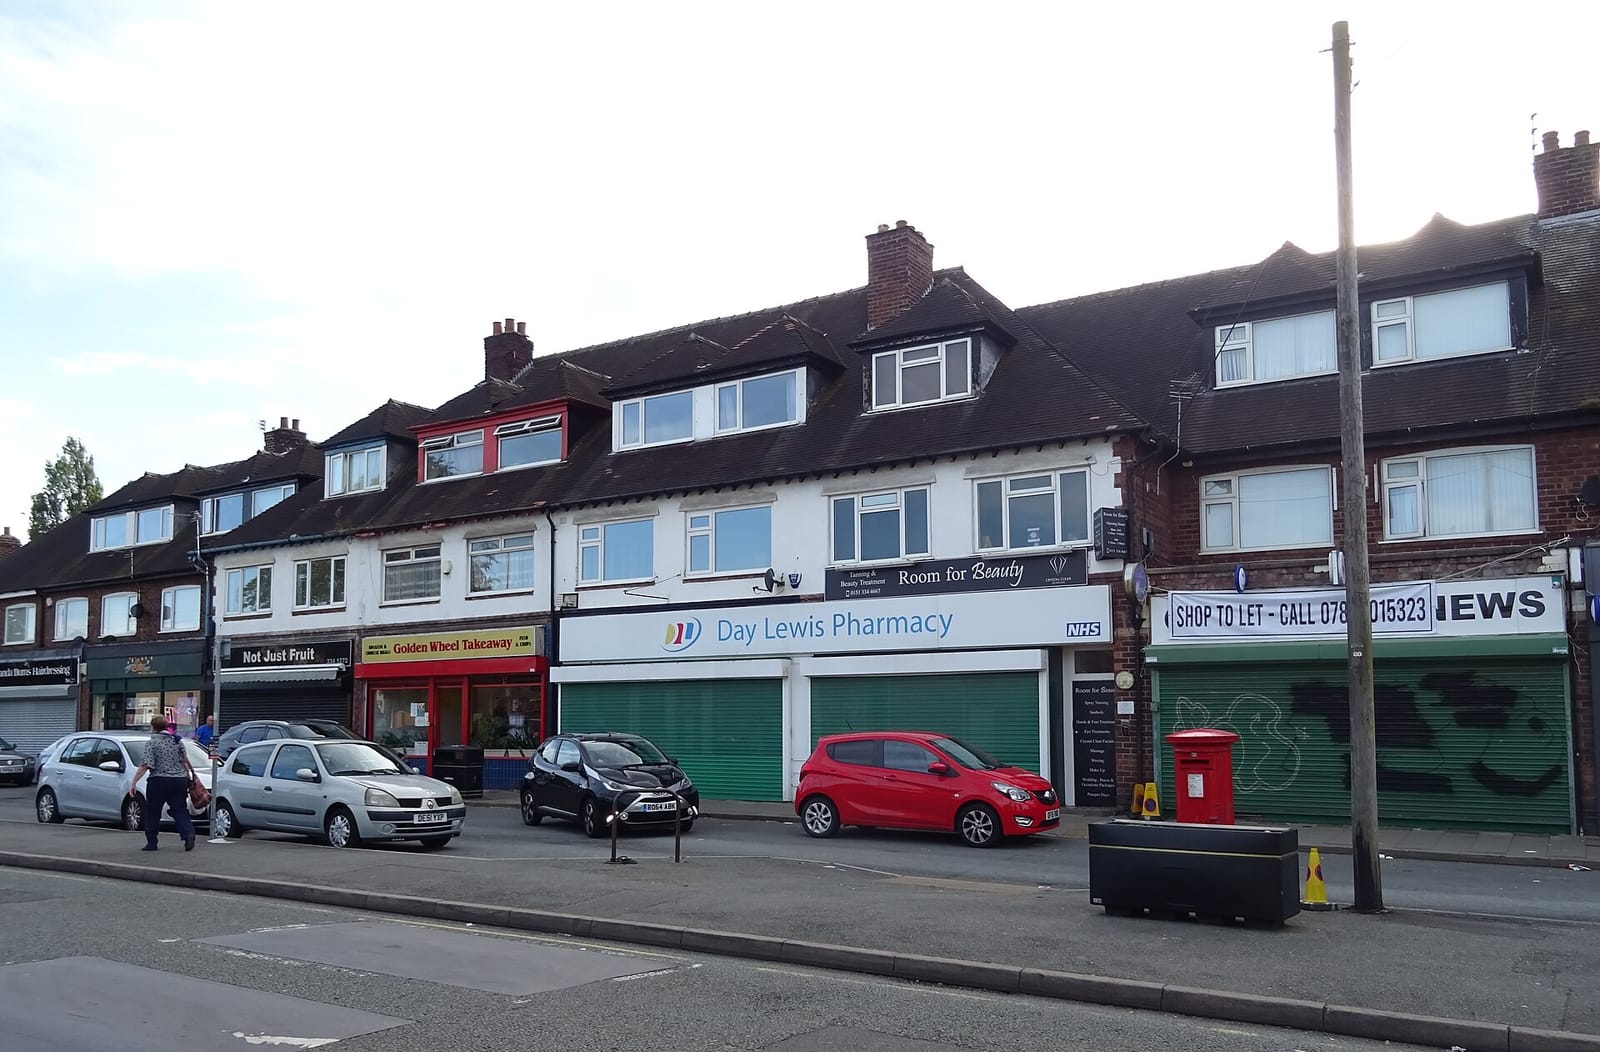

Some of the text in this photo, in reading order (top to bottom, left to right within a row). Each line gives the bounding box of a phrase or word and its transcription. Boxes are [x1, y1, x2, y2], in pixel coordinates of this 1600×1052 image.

[899, 560, 1024, 587] Room for Beauty
[1176, 604, 1212, 628] SHOP
[1216, 604, 1234, 627] TO
[1239, 603, 1264, 627] LET
[1280, 601, 1316, 627] CALL
[717, 611, 954, 648] Day Lewis Pharmacy
[1067, 622, 1100, 637] NHS
[393, 637, 512, 655] Golden Wheel Takeaway
[243, 648, 315, 663] Not Just Fruit
[32, 664, 71, 676] Hairdressing
